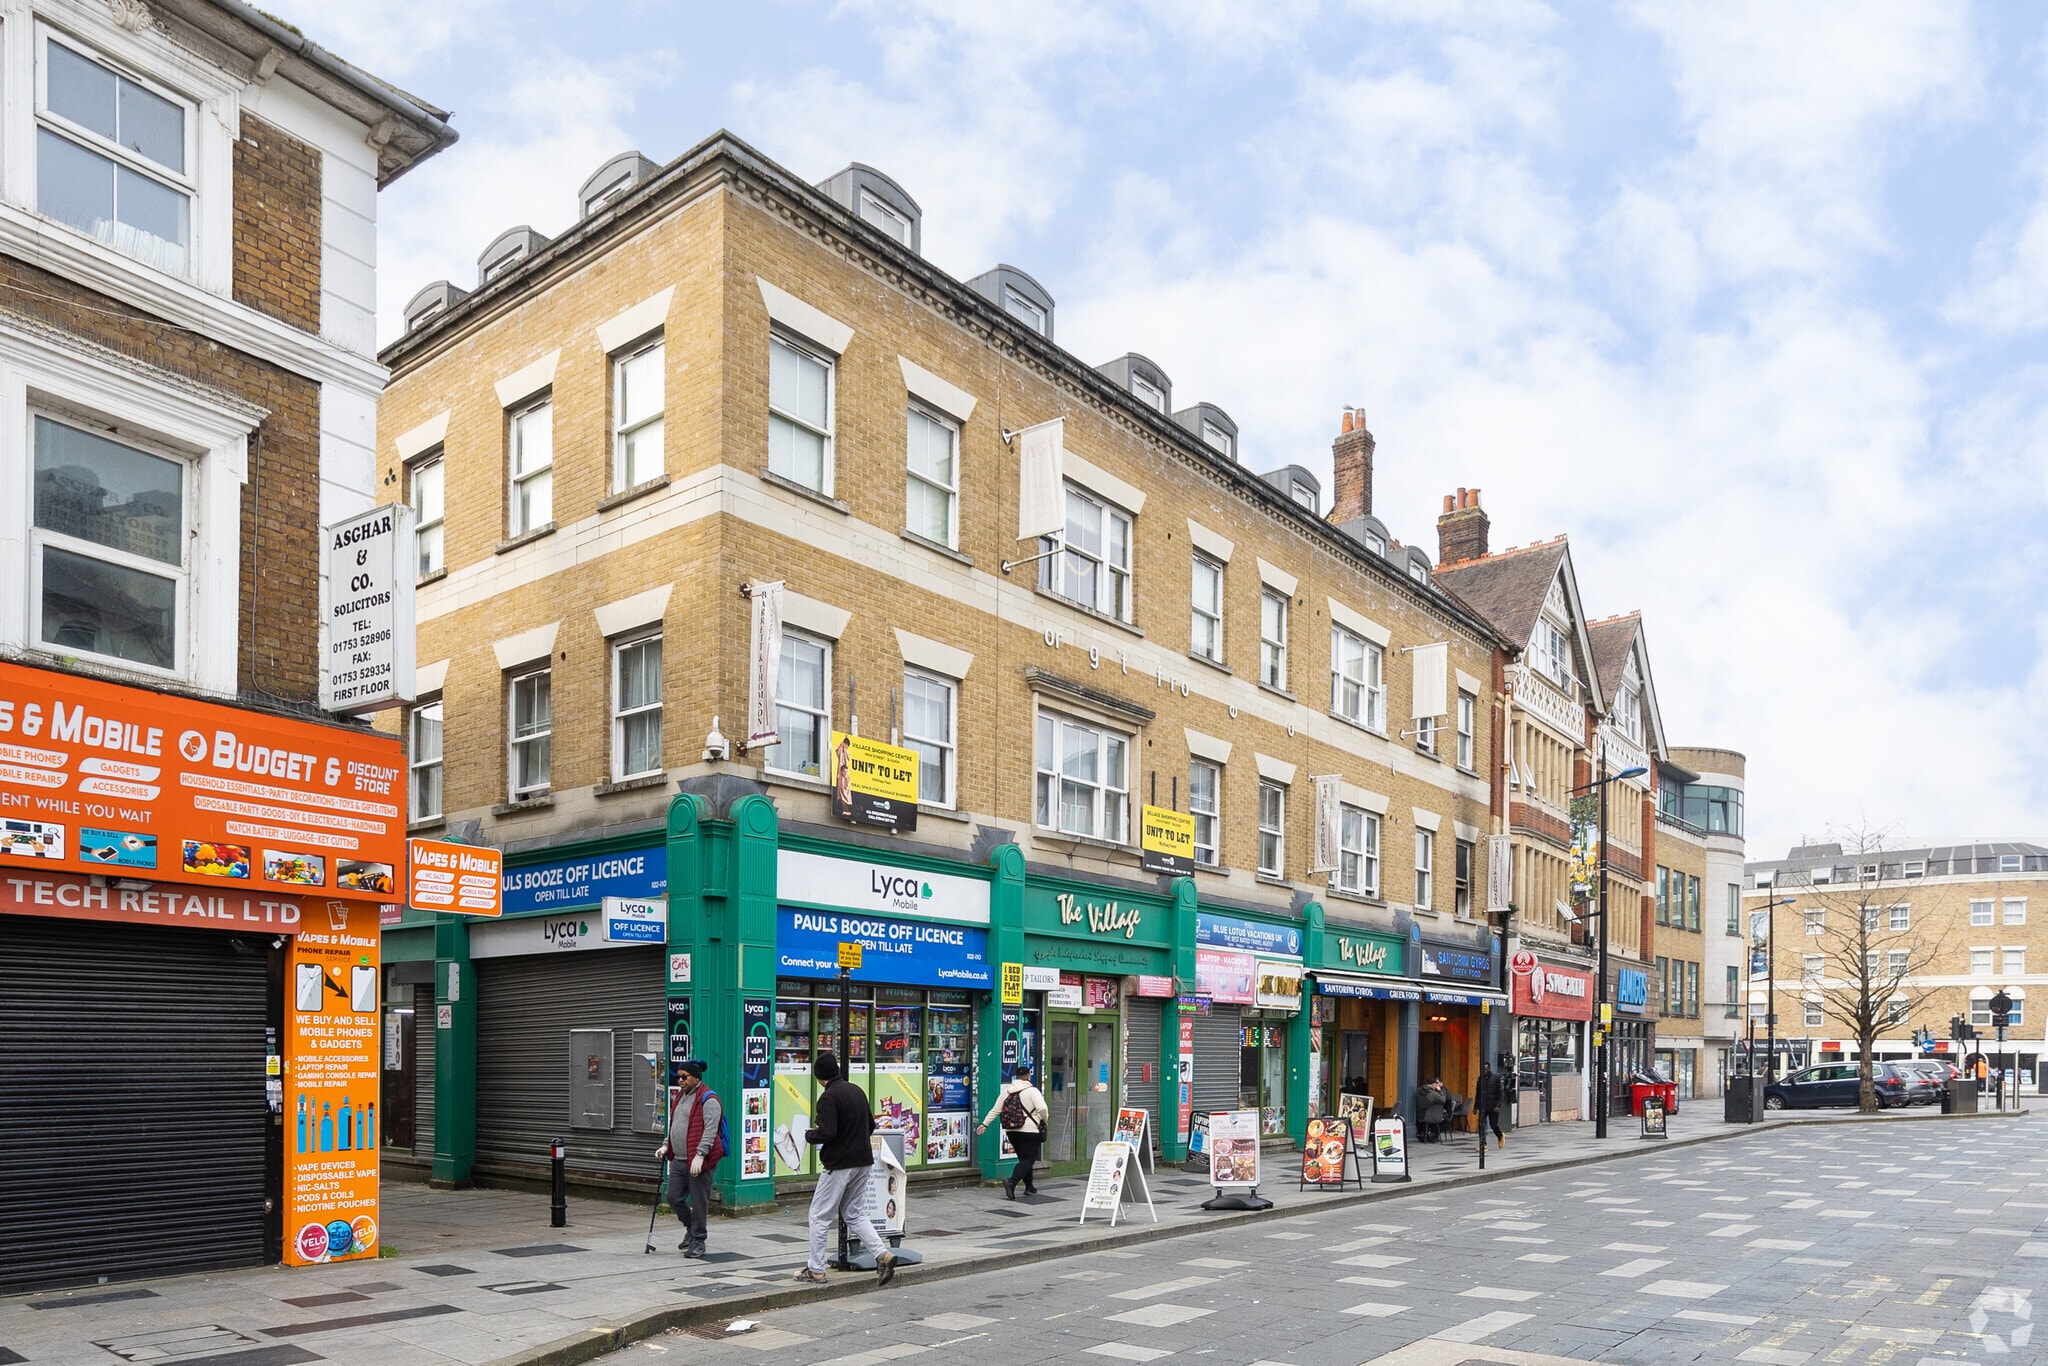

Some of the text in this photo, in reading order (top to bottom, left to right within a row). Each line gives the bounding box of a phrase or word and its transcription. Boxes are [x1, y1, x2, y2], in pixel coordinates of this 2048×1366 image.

[333, 516, 392, 550] ASGHAR
[356, 549, 368, 565] &
[351, 573, 373, 592] CO.
[334, 591, 390, 617] SOLICITORS
[353, 619, 371, 632] TEL:
[333, 629, 391, 654] 01753 528906
[352, 651, 371, 665] FAX:
[333, 663, 391, 685] 01753 529334
[334, 680, 389, 701] FIRST FLOOR
[22, 703, 43, 736] &
[51, 701, 163, 757] MOBILE
[24, 749, 63, 765] PHONES
[213, 730, 341, 786] BUDGET &
[852, 743, 912, 762] VILLAGE SHOPPING CENTRE
[101, 763, 140, 777] GADGETS
[347, 761, 399, 782] DISCOUNT
[852, 759, 875, 774] UNIT
[878, 765, 890, 778] TO
[894, 768, 912, 783] LET
[25, 771, 62, 785] REPAIRS
[92, 782, 149, 797] ACCESSORIES
[355, 777, 390, 795] STORE
[182, 775, 396, 816] HOUSEHOLD GIFTS ITEMS
[36, 797, 152, 823] WHILE YOU WAIT
[195, 797, 259, 815] DISPOSABLE PARTY
[229, 822, 358, 848] WATCH CUTTING
[1146, 825, 1190, 844] UNIT TO LET
[414, 846, 498, 874] VAPES & MOBILE
[524, 870, 563, 890] BOOZE
[566, 866, 589, 884] OFF
[592, 856, 644, 880] LICENCE
[872, 869, 918, 898] Lyca
[7, 878, 301, 925] TECH RETAIL LTD
[534, 886, 589, 902] OPEN TILL LATE
[621, 902, 645, 914] Lyca
[892, 898, 918, 910] Mobile
[1057, 893, 1141, 939] The Village
[544, 920, 577, 943] Lyca
[630, 924, 660, 932] LICENCE
[794, 913, 963, 946] PAULS BOOZE OFF LICENCE
[1213, 924, 1283, 942] BLUE LOTUS VACATIONS UK
[297, 931, 376, 947] VAPES & MOBILE
[558, 940, 576, 949] Mobile
[854, 939, 912, 954] OPEN TILL LATE
[1262, 939, 1273, 947] AGENT
[1339, 938, 1387, 970] The Village
[1438, 952, 1490, 970] SANTORINI GYROS
[781, 955, 813, 968] Connect
[815, 958, 832, 969] your
[938, 968, 989, 981] LycaMobile.co.uk
[1008, 966, 1020, 975] BED
[1452, 967, 1467, 976] GREEK
[1008, 974, 1020, 983] BED
[1030, 974, 1054, 983] TAILORS
[1004, 982, 1020, 991] FLAT
[1325, 984, 1373, 997] SANTORINI GYROS
[1389, 990, 1419, 999] GREEK FOOD
[1430, 993, 1467, 1003] SANTORINI GYROS
[669, 1001, 684, 1012] Lyca
[744, 1003, 764, 1014] Lyca
[296, 1015, 376, 1025] WE BUY AND SELL
[1002, 1013, 1015, 1021] Lyca
[300, 1027, 372, 1037] MOBILE PHONES
[311, 1040, 362, 1048] & GADGETS
[884, 1038, 909, 1050] OPEN
[788, 1086, 799, 1099] Wine
[321, 1161, 355, 1170] DEVICES
[357, 1169, 377, 1178] VAPE
[330, 1191, 354, 1200] COILS
[338, 1199, 376, 1209] POUCHES
[302, 1235, 327, 1247] VELO
